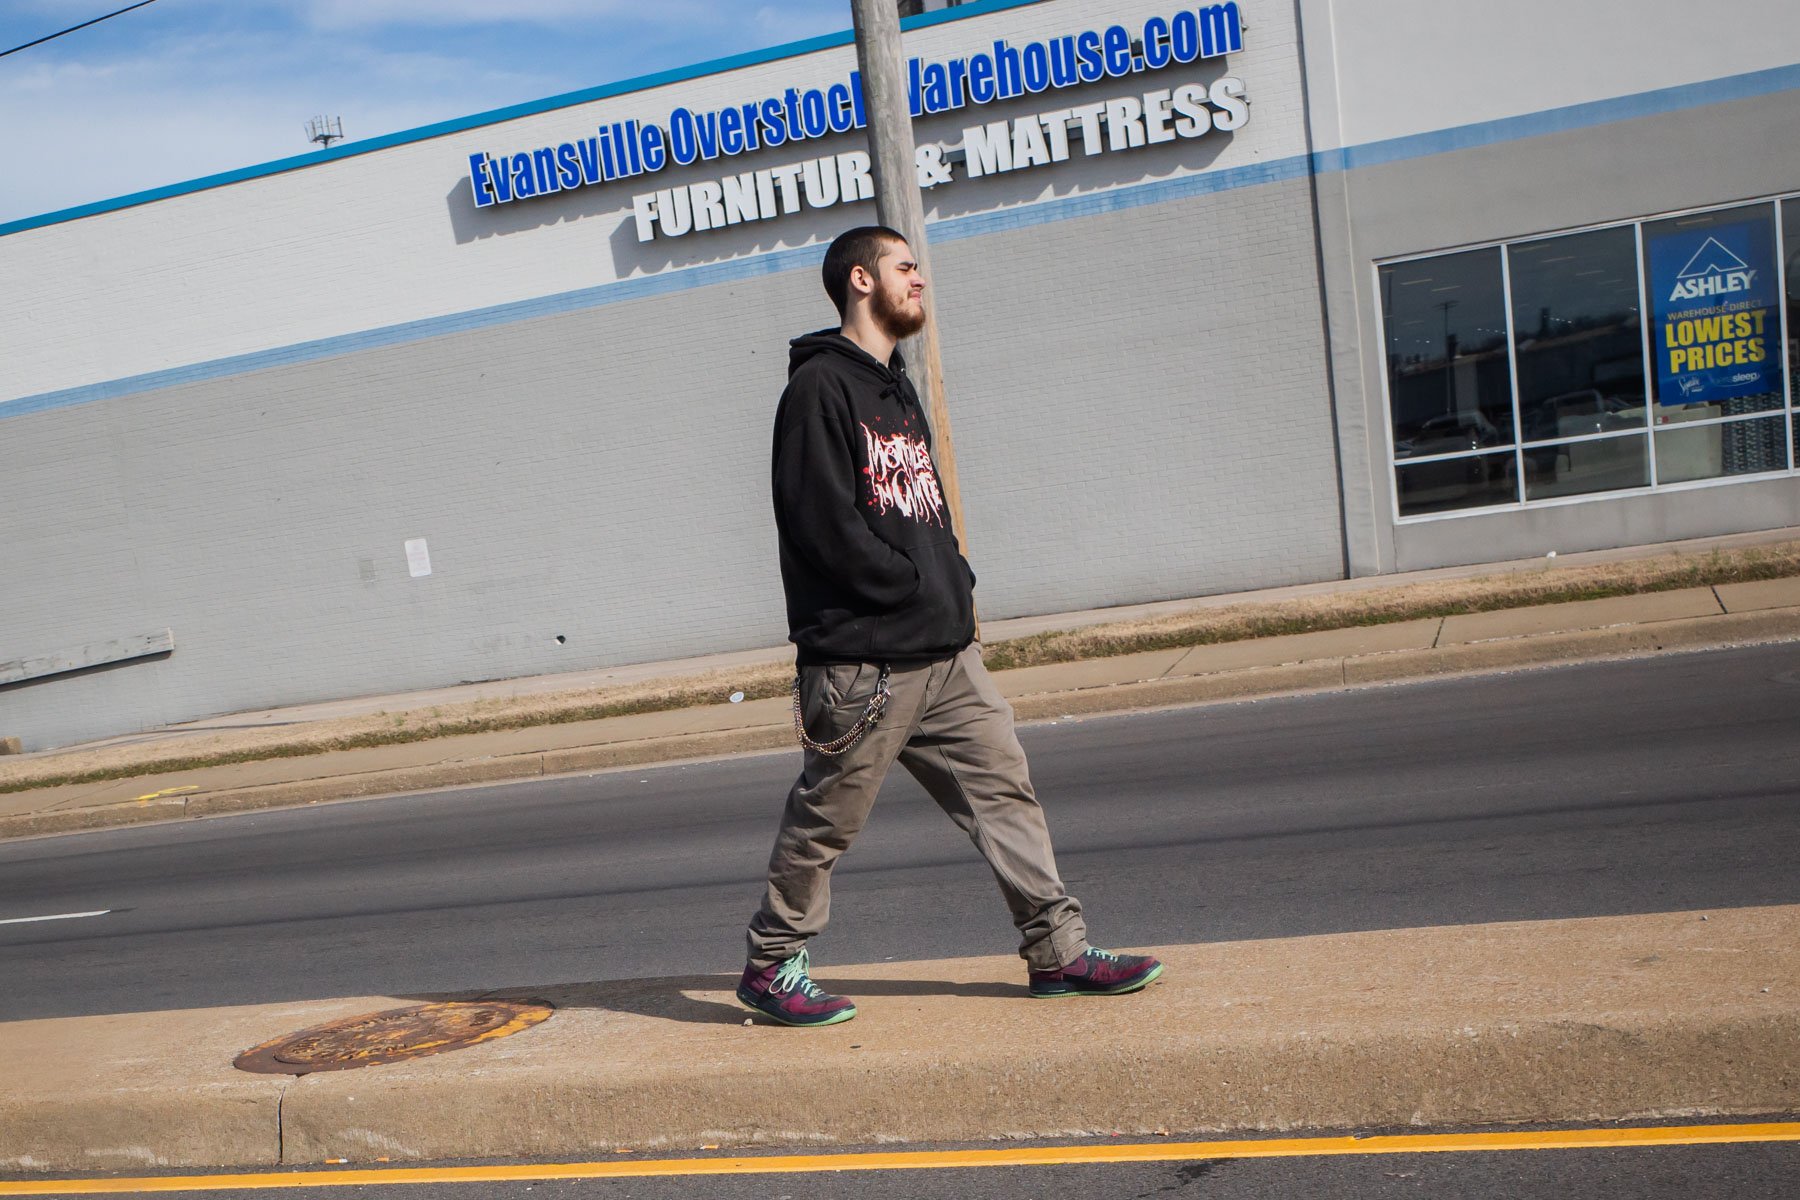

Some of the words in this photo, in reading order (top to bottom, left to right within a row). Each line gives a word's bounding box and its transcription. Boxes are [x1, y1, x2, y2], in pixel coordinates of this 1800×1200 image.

[632, 151, 875, 242] FURNITUR
[914, 143, 953, 188] &
[962, 77, 1250, 178] MATTRESS
[1669, 270, 1757, 301] ASHLEY
[1667, 304, 1727, 320] WAREHOUSE
[1729, 300, 1763, 311] DIRECT
[1665, 310, 1767, 348] LOWEST
[1670, 337, 1766, 374] PRICES
[1732, 372, 1757, 383] sleep
